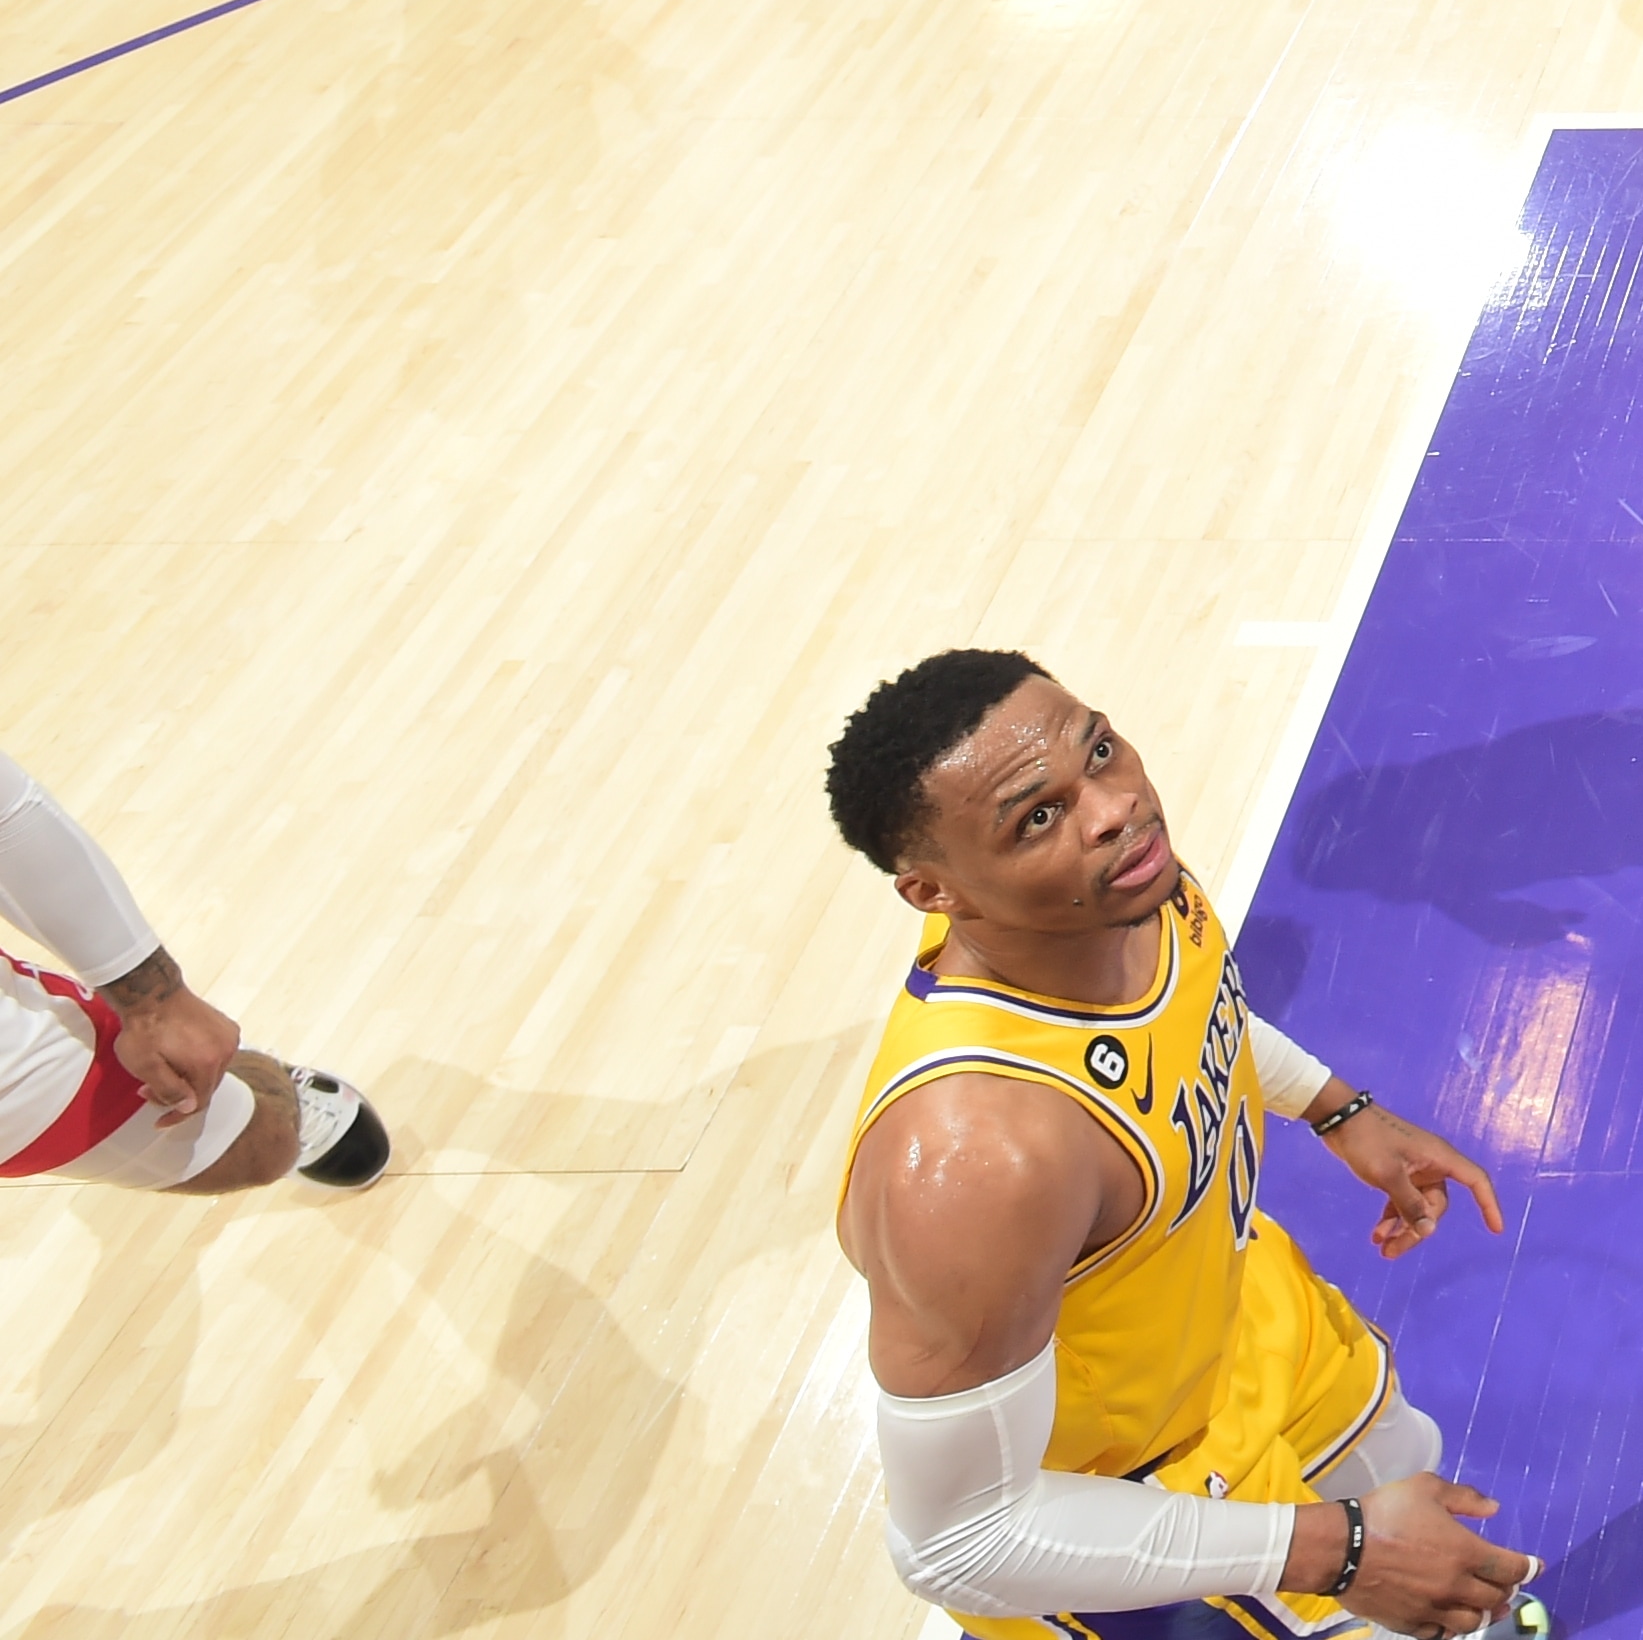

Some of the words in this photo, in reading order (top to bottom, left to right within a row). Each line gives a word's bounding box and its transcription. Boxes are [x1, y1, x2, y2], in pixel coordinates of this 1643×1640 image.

[1188, 895, 1207, 949] bibigo
[1090, 1043, 1126, 1082] 6
[1227, 1094, 1260, 1251] 0
